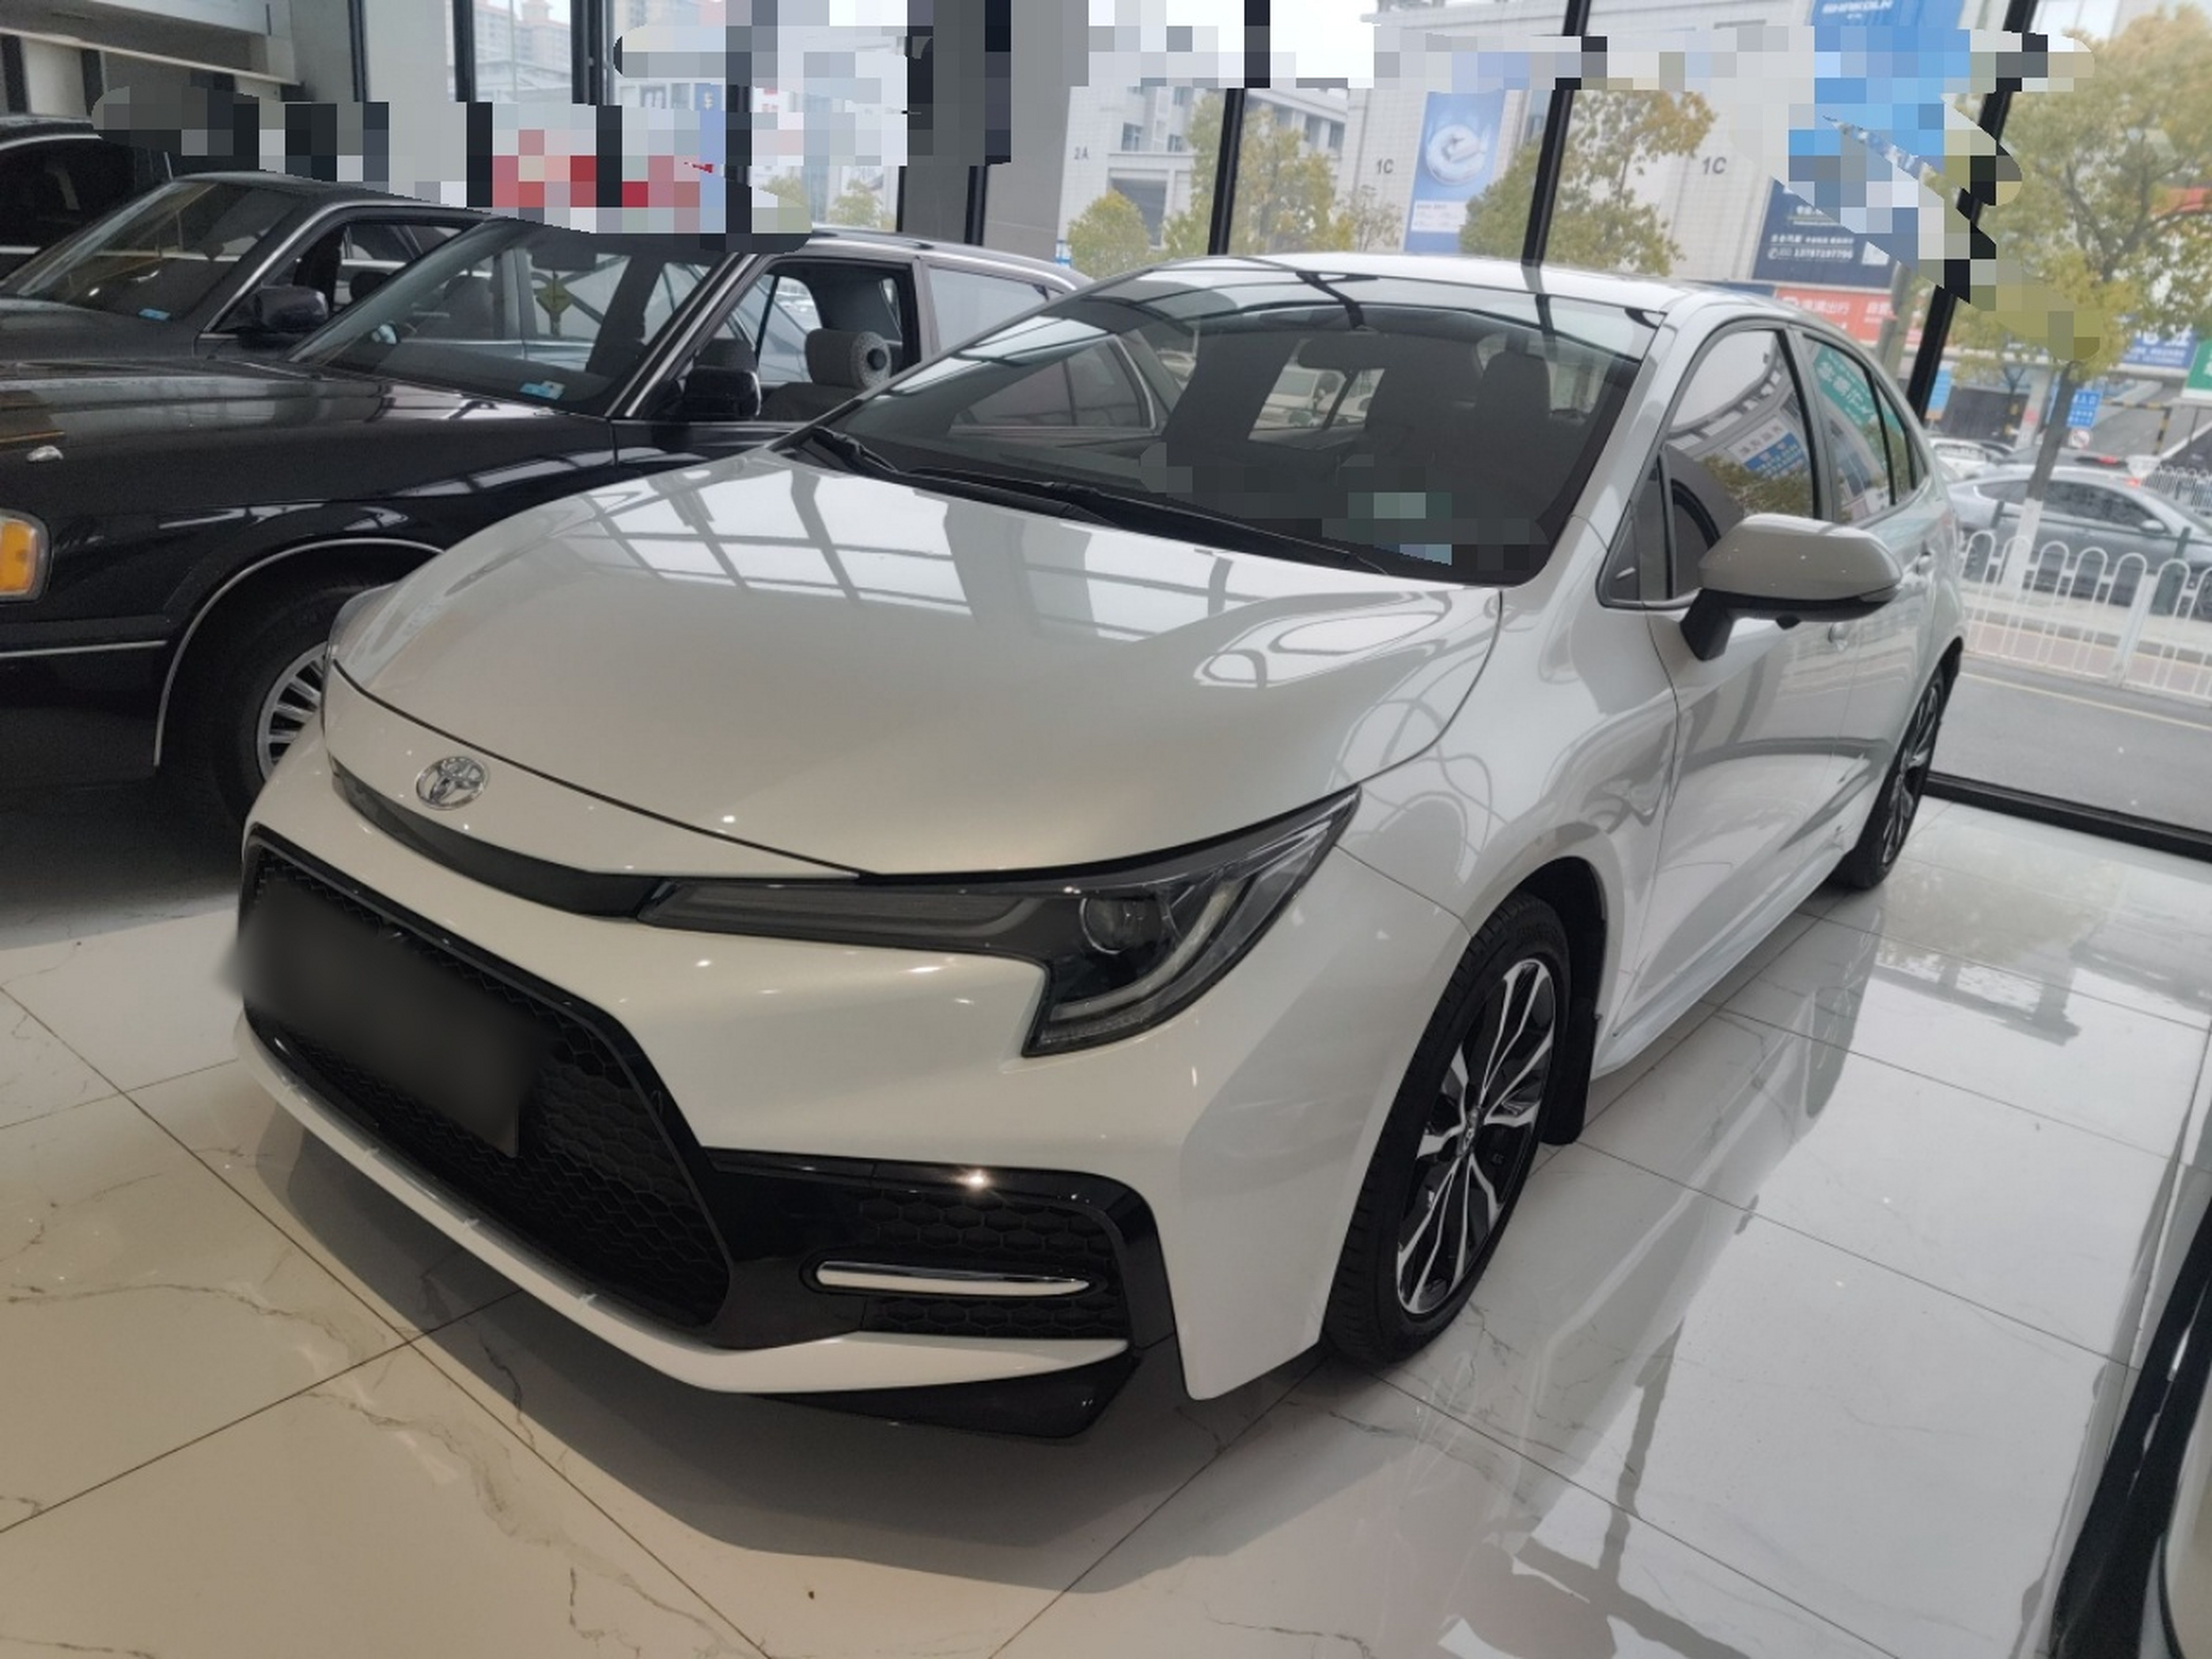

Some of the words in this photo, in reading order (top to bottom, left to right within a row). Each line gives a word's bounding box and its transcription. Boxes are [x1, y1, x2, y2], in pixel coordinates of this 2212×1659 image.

[1074, 146, 1089, 160] 2A
[1377, 158, 1394, 175] 1C
[1702, 156, 1727, 175] 1C
